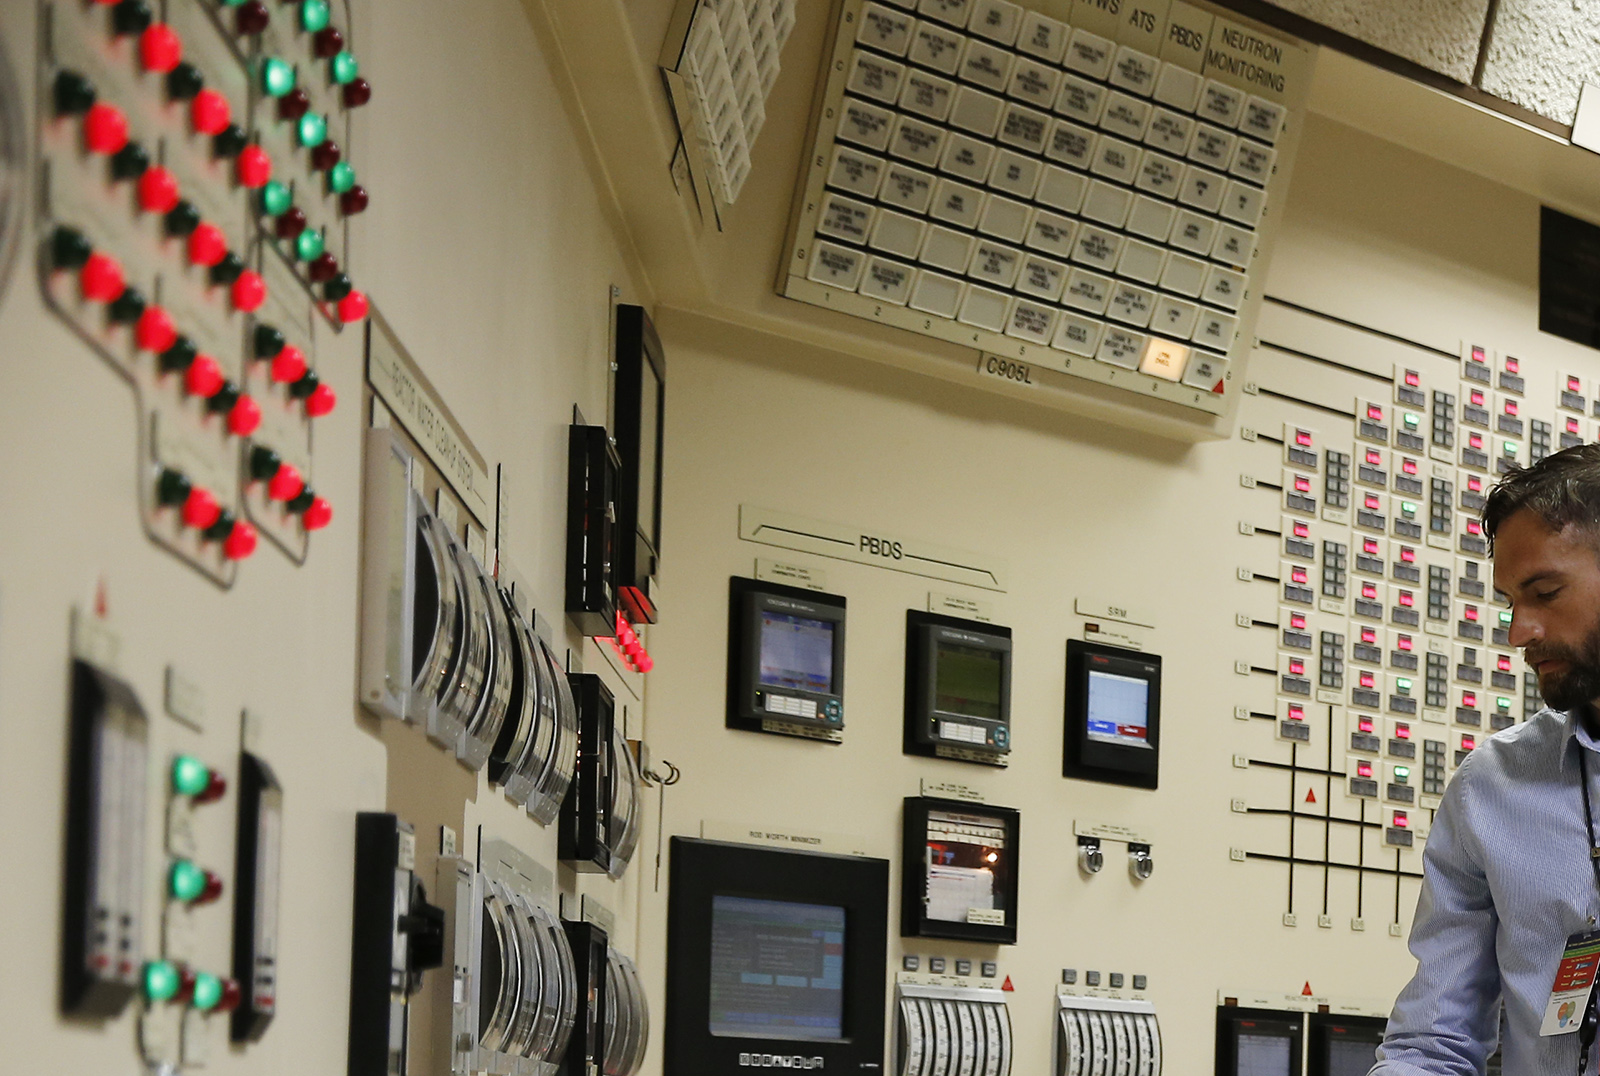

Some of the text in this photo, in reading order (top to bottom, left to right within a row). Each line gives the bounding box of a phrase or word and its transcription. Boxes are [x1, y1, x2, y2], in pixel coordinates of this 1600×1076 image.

[1128, 8, 1156, 34] ATS
[1168, 22, 1203, 52] PBDS
[1222, 27, 1283, 65] NEUTRON
[1207, 50, 1286, 93] MONITORING
[986, 356, 1032, 385] C905L
[859, 535, 903, 560] PBDS
